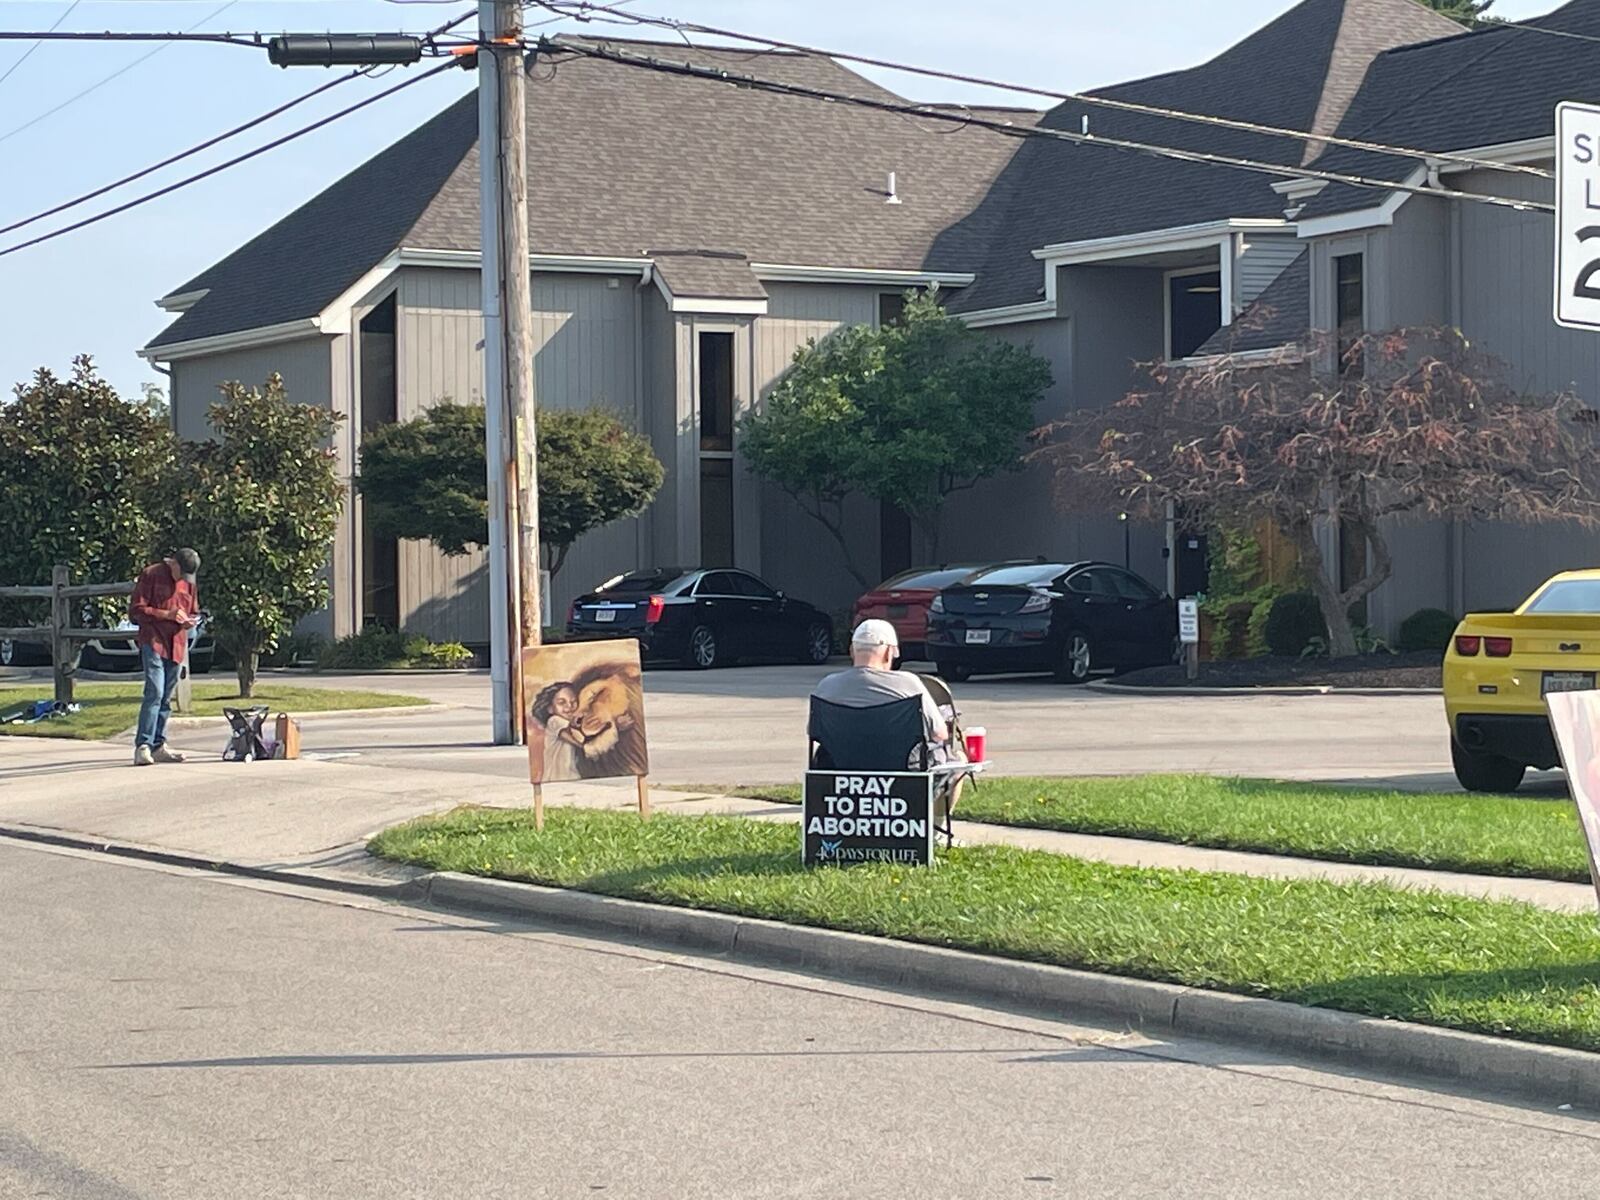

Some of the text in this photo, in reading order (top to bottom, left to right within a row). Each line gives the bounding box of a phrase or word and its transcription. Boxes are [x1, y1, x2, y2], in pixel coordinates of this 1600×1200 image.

[835, 776, 895, 795] PRAY
[824, 796, 907, 816] TO END
[808, 817, 926, 838] ABORTION
[836, 847, 864, 860] DAYS
[865, 847, 890, 863] FOR
[891, 848, 919, 862] LIFE
